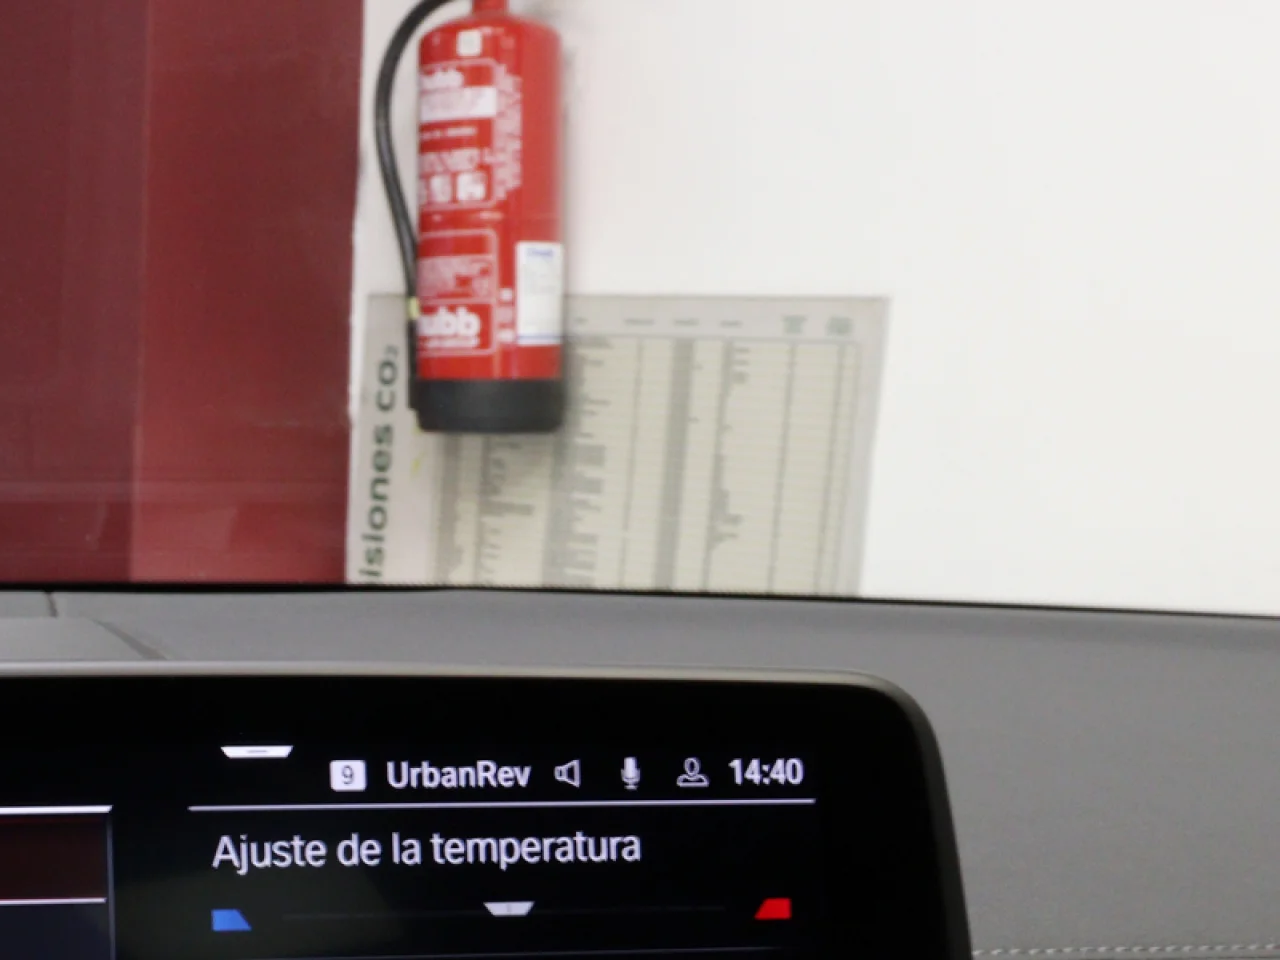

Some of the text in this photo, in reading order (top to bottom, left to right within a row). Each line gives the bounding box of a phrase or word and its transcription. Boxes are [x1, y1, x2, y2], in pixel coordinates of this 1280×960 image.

[360, 424, 394, 578] isiones
[387, 760, 532, 788] UrbanRev
[728, 757, 805, 785] 14:40
[212, 831, 641, 875] Ajuste de la temperatura
